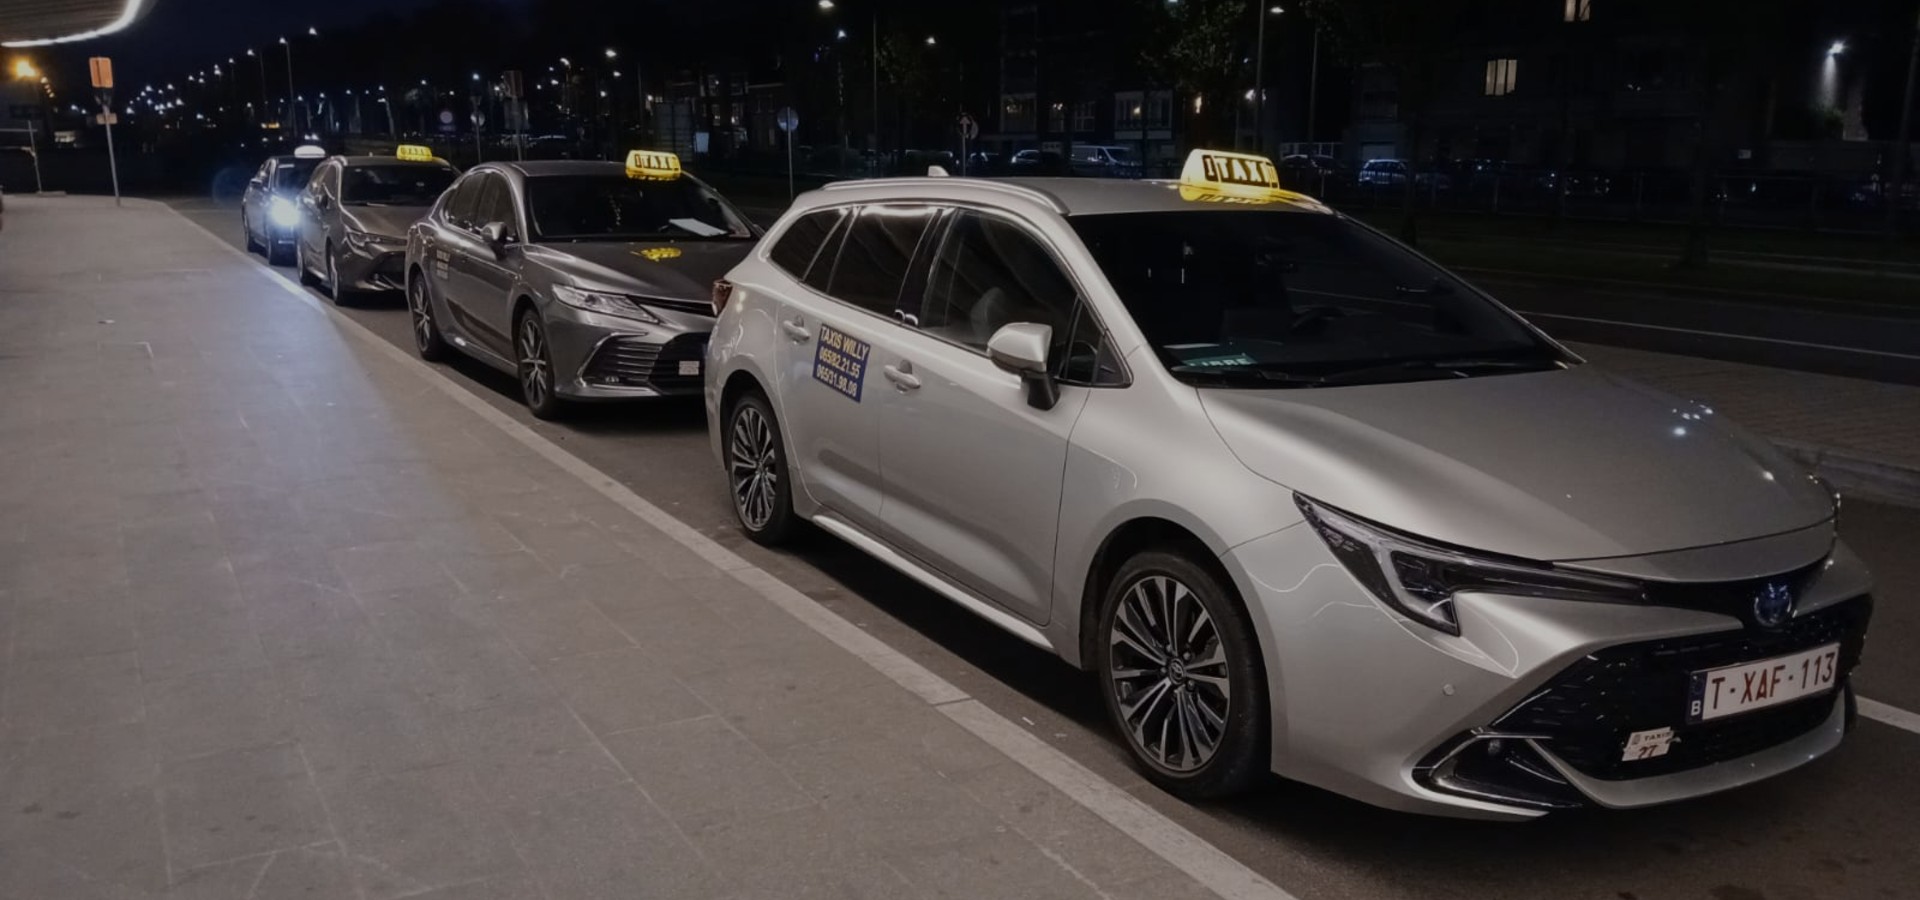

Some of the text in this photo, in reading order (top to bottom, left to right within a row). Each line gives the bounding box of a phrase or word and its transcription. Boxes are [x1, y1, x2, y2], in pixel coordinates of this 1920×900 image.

[1216, 157, 1270, 183] TAXI
[821, 327, 869, 361] TAXIS WILLY
[1689, 699, 1702, 716] B
